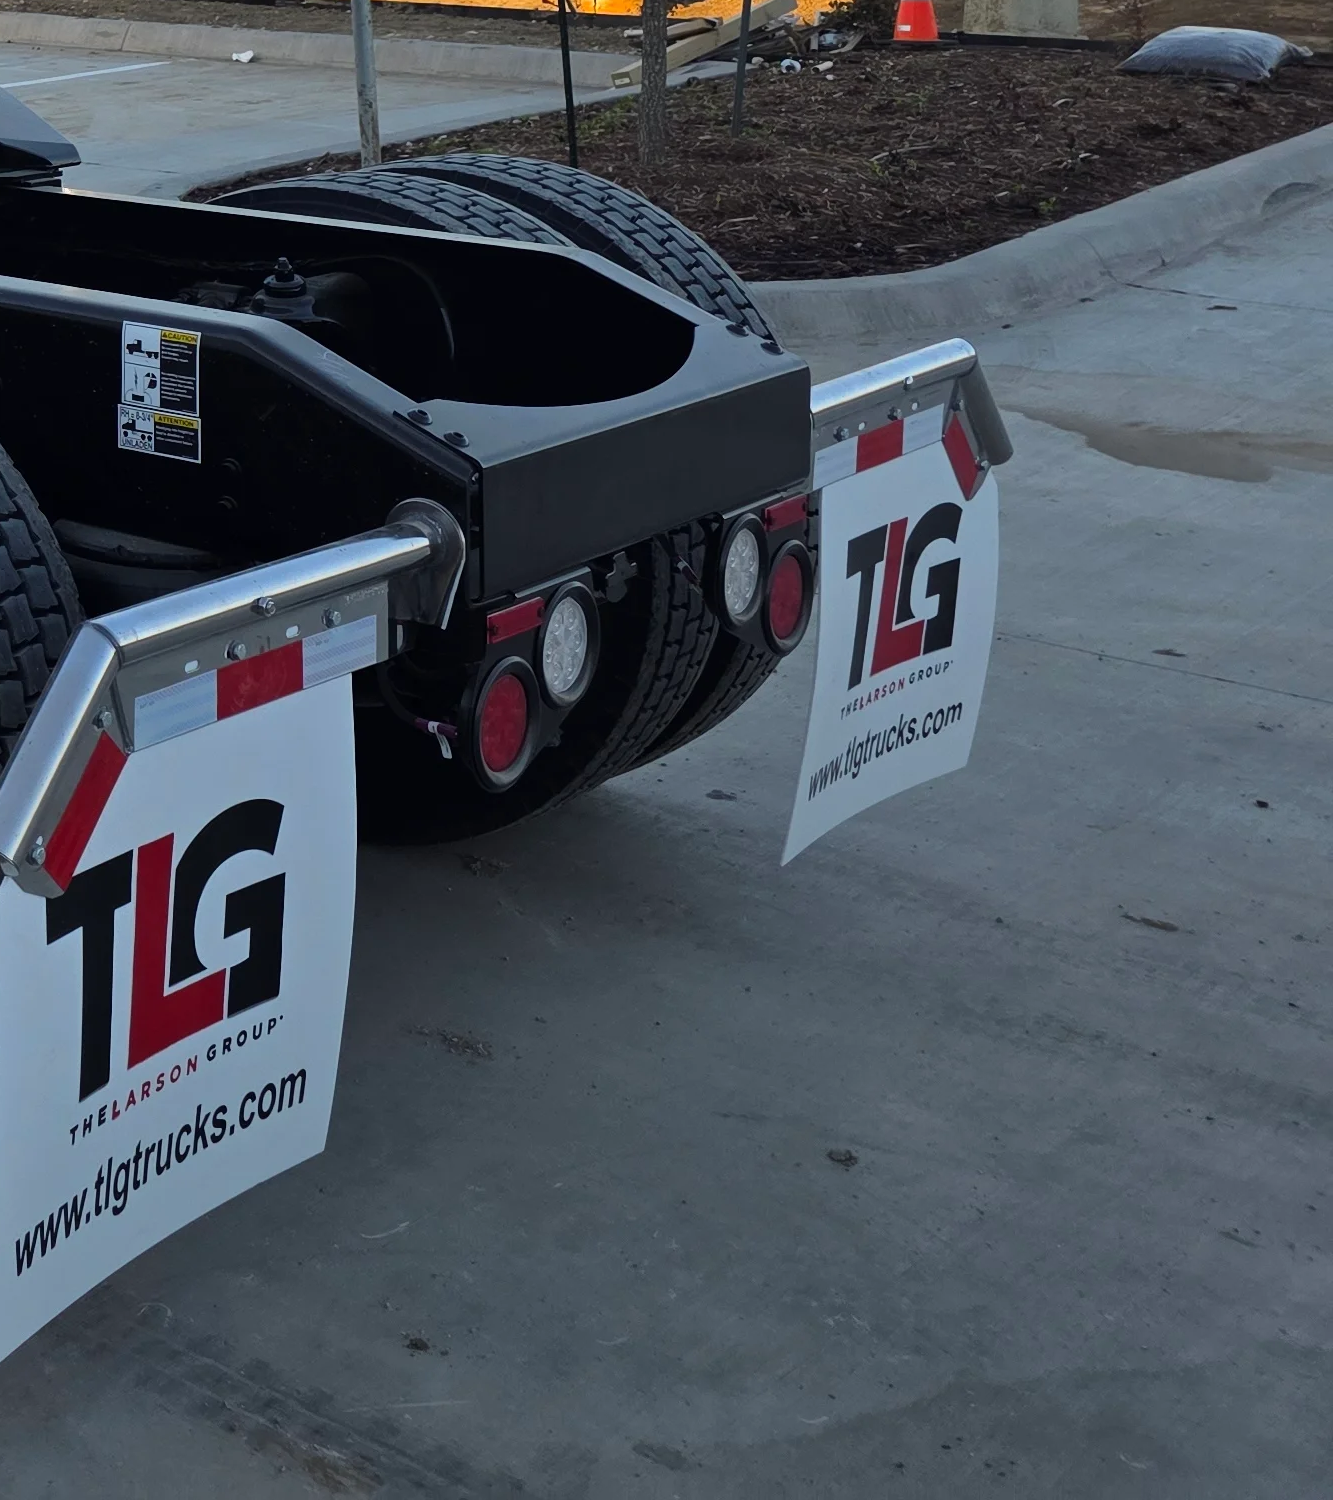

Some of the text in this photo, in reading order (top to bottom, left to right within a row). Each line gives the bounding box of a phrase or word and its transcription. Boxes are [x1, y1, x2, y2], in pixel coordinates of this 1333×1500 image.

[167, 332, 197, 343] CAUTION
[120, 437, 153, 450] UNLADEN
[158, 415, 194, 427] ATTENTION
[846, 502, 963, 691] TLG
[908, 660, 950, 684] GROUP
[808, 702, 962, 801] www.tlgtrucks.com
[45, 798, 286, 1103] TLG
[206, 1017, 277, 1062] GROUP
[15, 1068, 307, 1277] www.tlgtrucks.com
